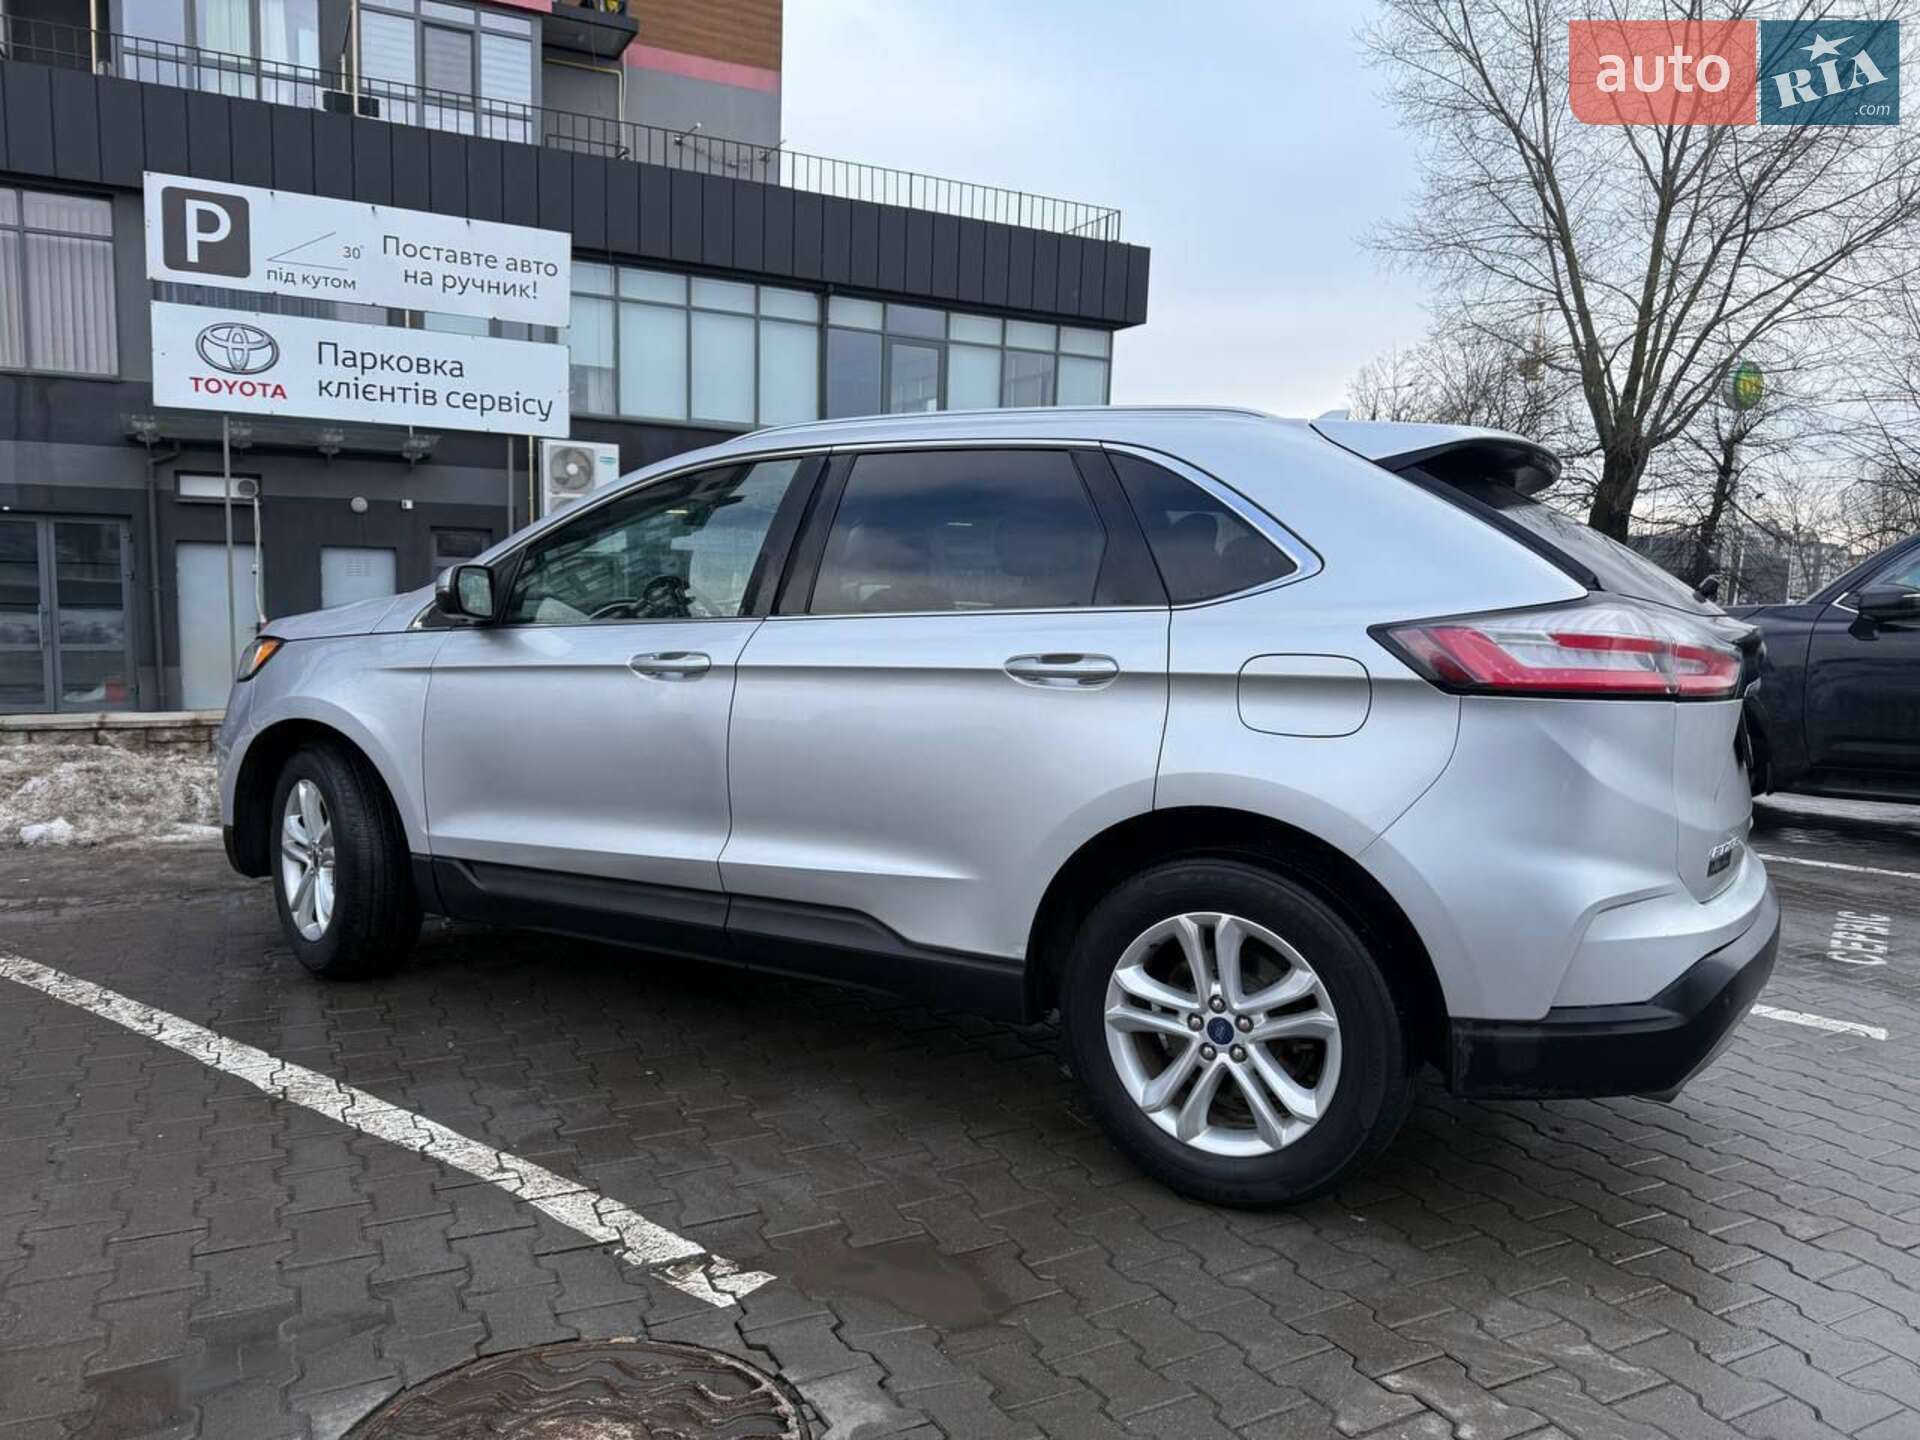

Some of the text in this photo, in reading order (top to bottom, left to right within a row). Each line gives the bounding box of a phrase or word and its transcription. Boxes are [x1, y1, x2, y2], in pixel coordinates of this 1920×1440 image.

[184, 199, 232, 264] P
[383, 235, 559, 278] Поставте авто
[266, 267, 357, 291] під кутом
[404, 269, 538, 300] на ручник!
[318, 341, 464, 379] Парковка
[189, 376, 287, 400] TOYOTA
[318, 377, 553, 422] клієнтів сервісу
